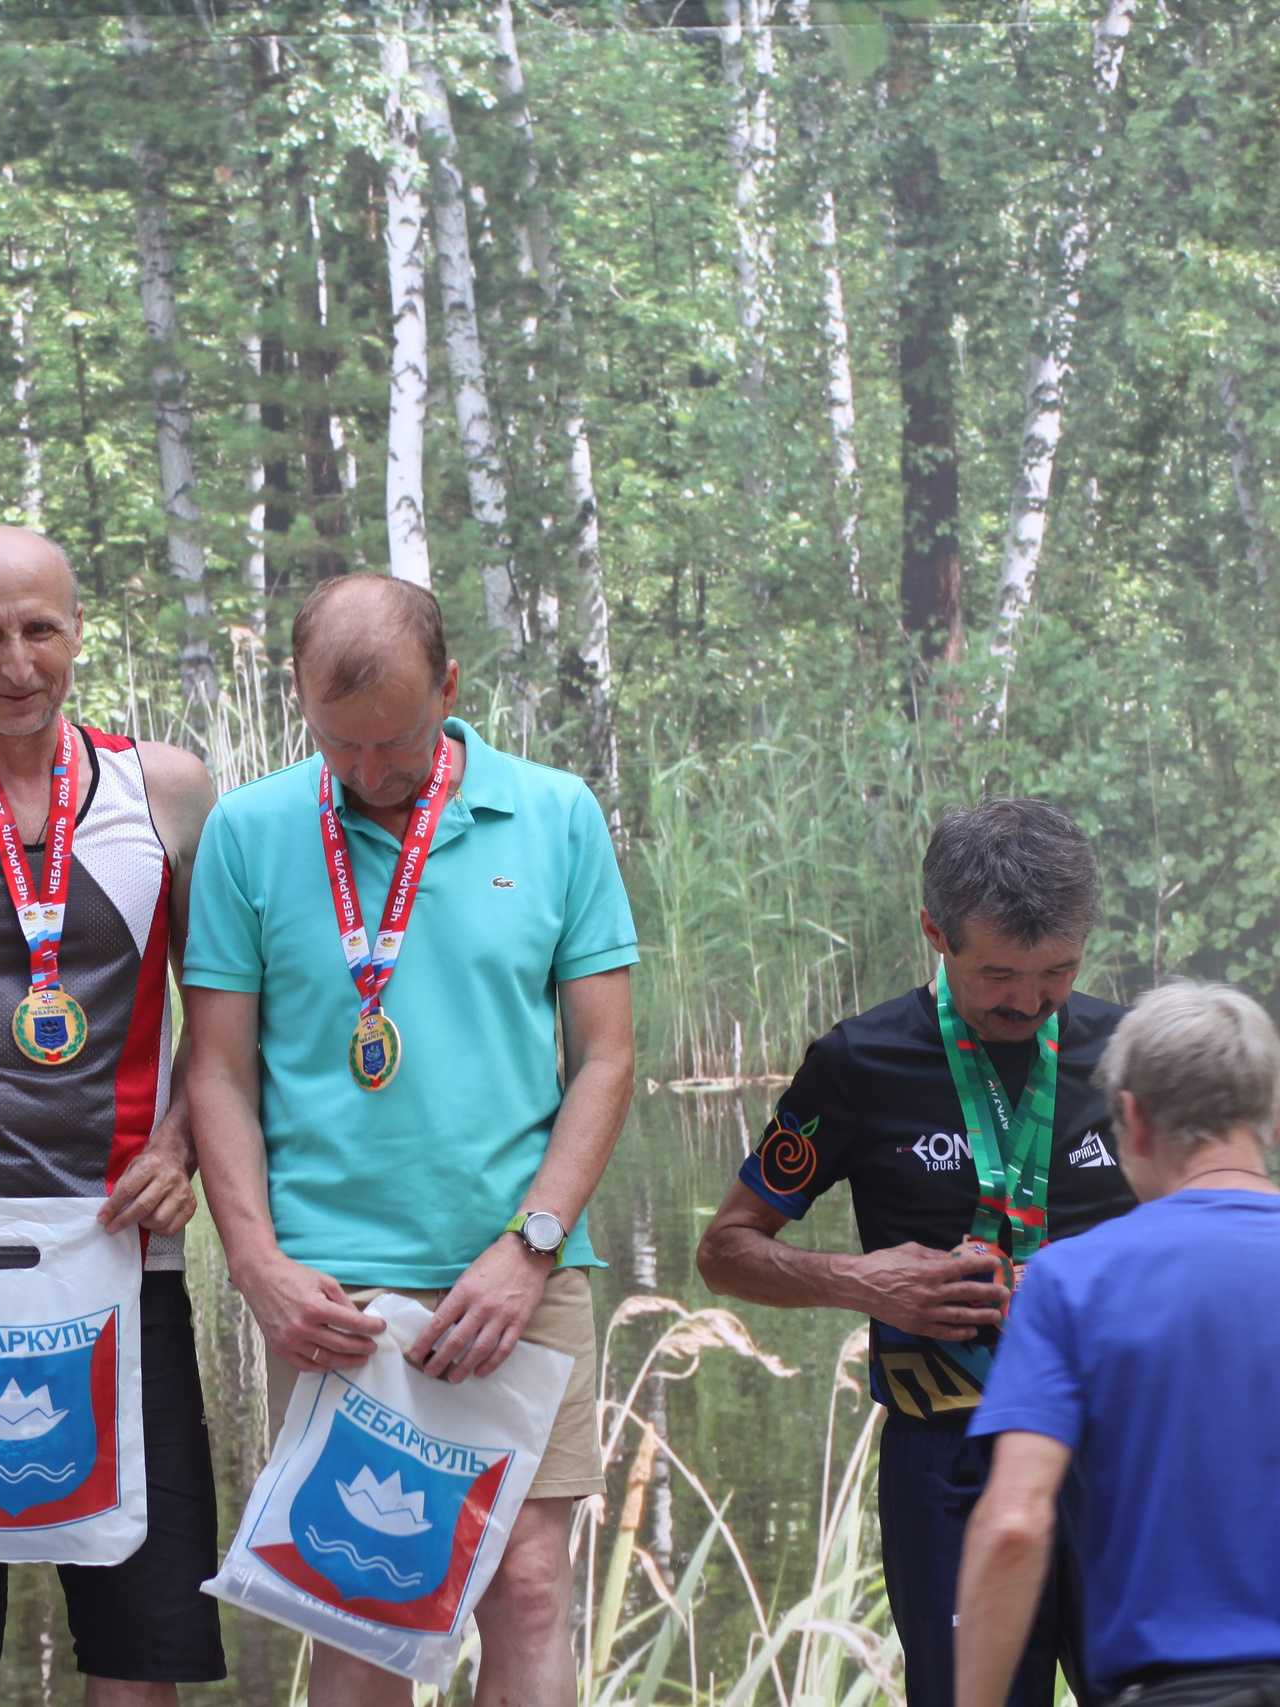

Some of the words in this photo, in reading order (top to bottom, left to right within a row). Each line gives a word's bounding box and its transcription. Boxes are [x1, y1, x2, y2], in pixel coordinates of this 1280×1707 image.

[1, 823, 29, 901] ЧЕБАРКУЛЬ
[49, 816, 67, 894] ЧЕБАРКУЛЬ
[59, 777, 70, 807] 2024
[326, 809, 338, 840] 2024
[334, 849, 356, 927] ЧЕБАРКУЛЬ
[390, 845, 420, 922] ЧЕБАРКУЛЬ
[414, 809, 432, 838] 2024
[925, 1160, 961, 1172] TOURS
[1068, 1142, 1101, 1165] UPHILL
[342, 1387, 489, 1475] ЧЕБАРКУЛЬ
